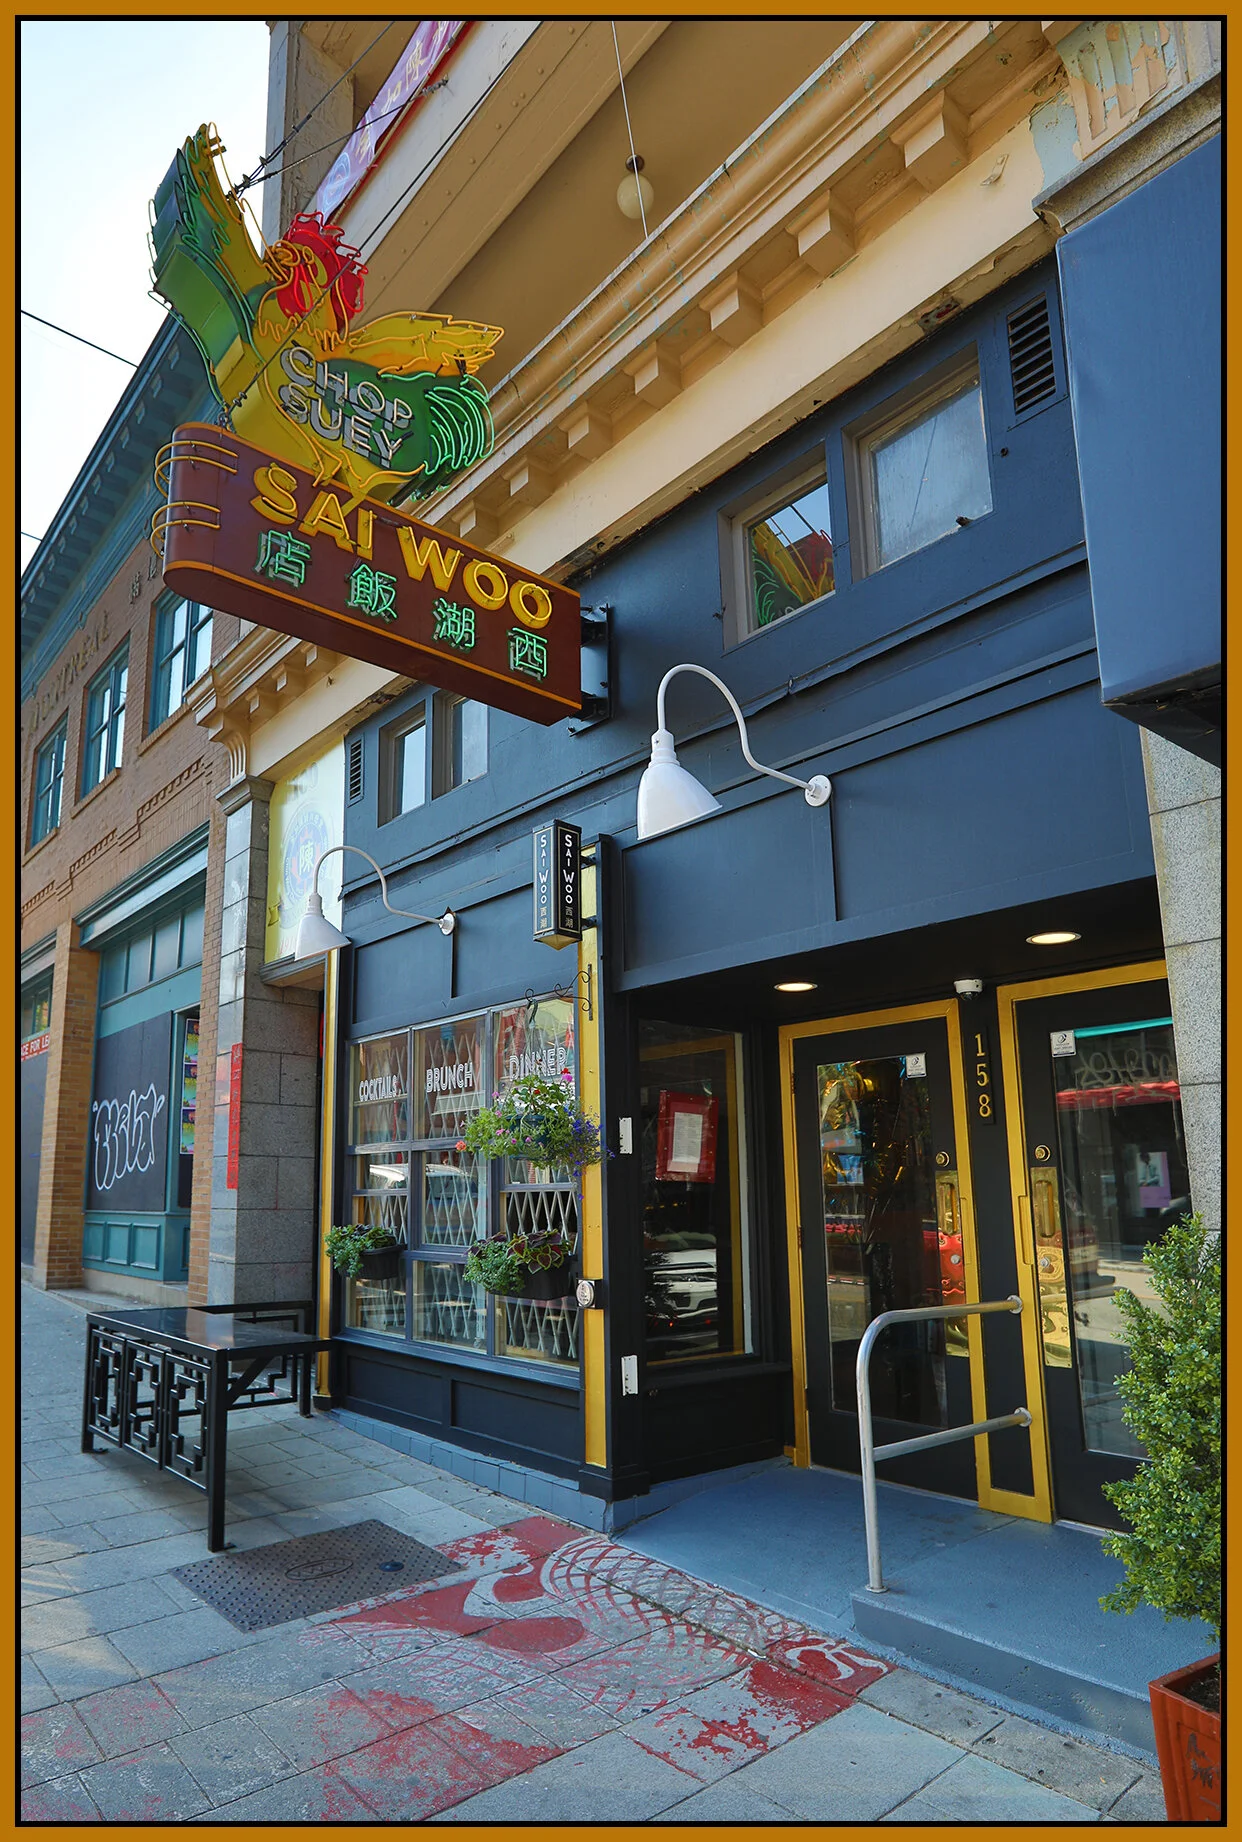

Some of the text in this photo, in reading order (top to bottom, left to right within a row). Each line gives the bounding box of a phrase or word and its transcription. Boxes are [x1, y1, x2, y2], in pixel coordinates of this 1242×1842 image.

[280, 346, 414, 432] CHOP
[279, 383, 404, 468] SUEY
[251, 463, 553, 629] SAI WOO
[539, 834, 549, 904] SAI WOO
[563, 834, 575, 904] SAI WOO
[30, 1039, 40, 1053] FOR
[426, 1062, 473, 1093] BRUNCH
[509, 1047, 567, 1082] DINNER
[974, 1032, 992, 1118] 158
[358, 1075, 398, 1102] COCKTAILS
